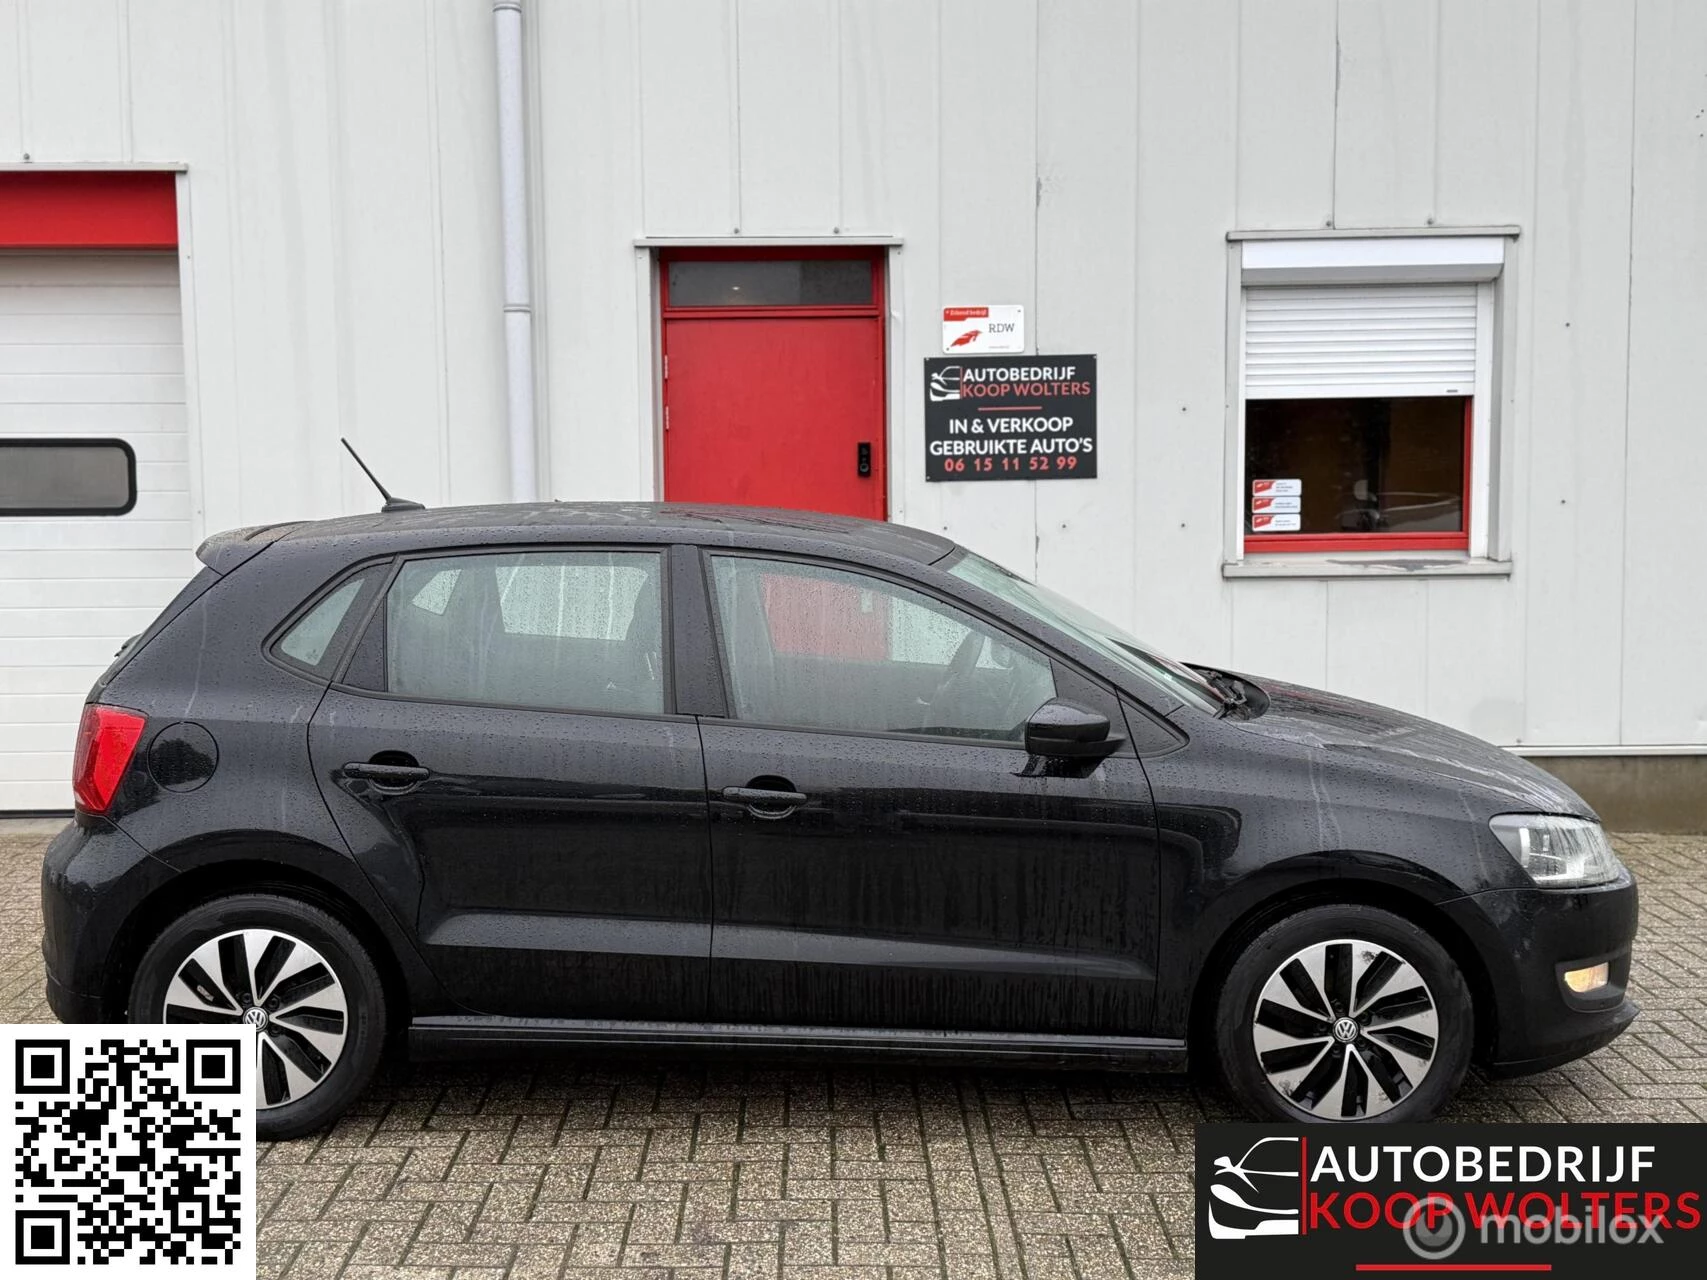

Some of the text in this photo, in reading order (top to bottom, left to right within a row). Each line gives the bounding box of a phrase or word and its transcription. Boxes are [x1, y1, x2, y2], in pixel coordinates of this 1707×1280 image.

[988, 323, 1015, 333] RDW
[963, 366, 1076, 382] AUTOBEDRIJF
[963, 382, 1091, 397] KOOP WOLTERS
[949, 417, 1074, 434] IN & VERKOOP
[930, 437, 1093, 456] GEBRUIKTE AUTO'S
[944, 456, 1078, 472] 06 15 11 52 99
